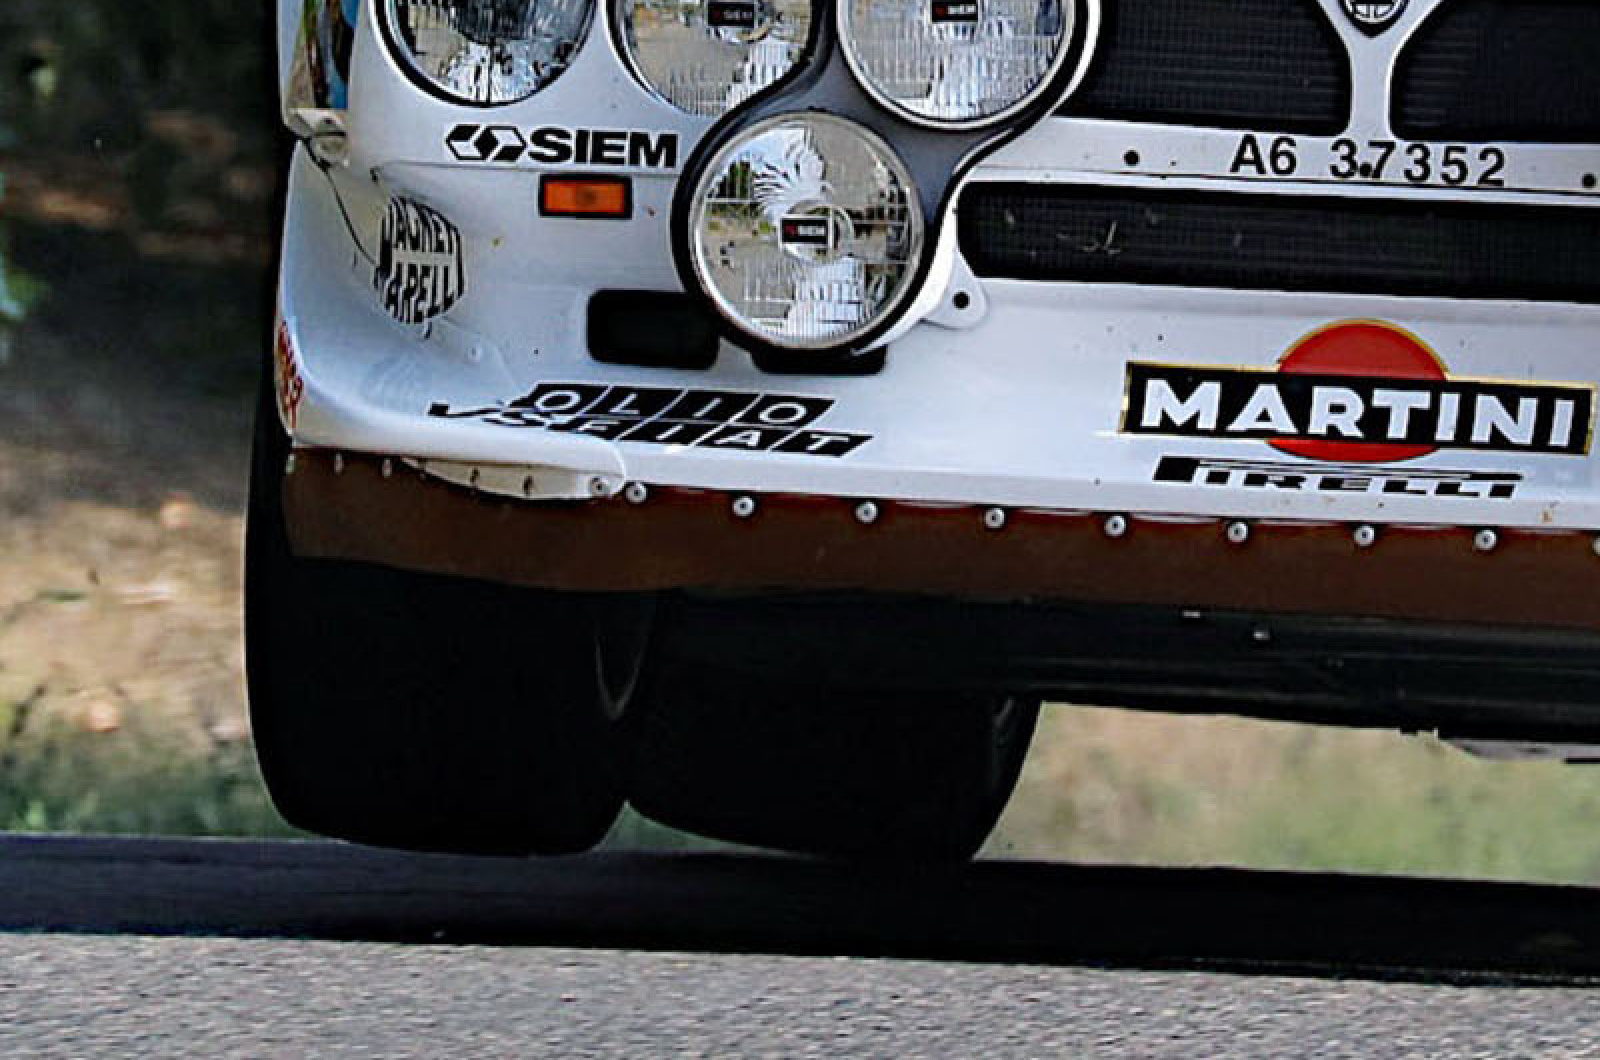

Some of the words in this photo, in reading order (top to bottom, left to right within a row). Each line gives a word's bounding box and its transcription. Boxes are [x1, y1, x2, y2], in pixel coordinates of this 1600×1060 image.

[528, 127, 679, 168] SIEM
[1230, 133, 1297, 176] A6
[526, 387, 816, 426] OLIO
[1141, 379, 1576, 447] MARTINI
[574, 419, 852, 452] FIAT
[1153, 455, 1524, 498] PIRELLI
